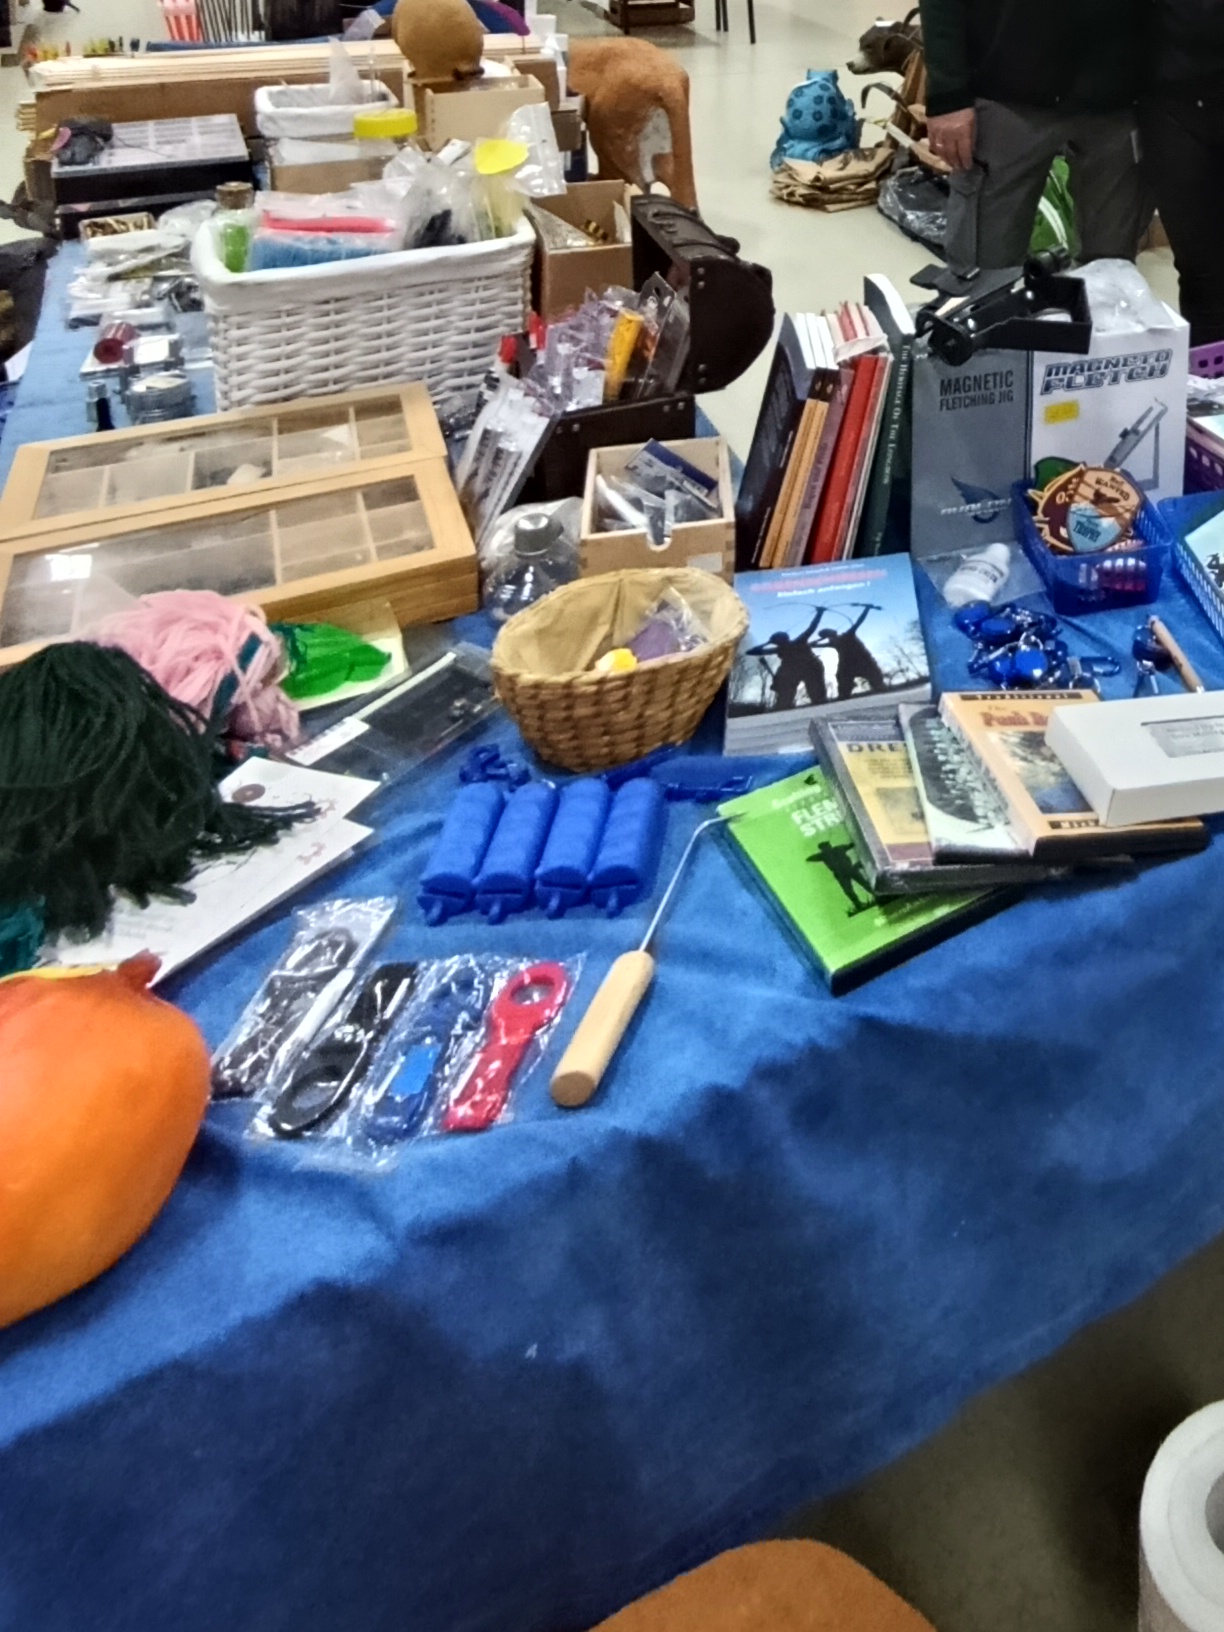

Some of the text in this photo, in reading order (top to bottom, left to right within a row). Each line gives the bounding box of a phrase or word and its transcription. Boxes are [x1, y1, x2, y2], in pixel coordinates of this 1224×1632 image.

[1045, 348, 1173, 378] MAGNETO
[939, 370, 1014, 397] MAGNETIC
[1040, 364, 1170, 395] FLETCH
[939, 389, 1014, 412] FLETCHING JIG
[847, 742, 908, 754] DRE
